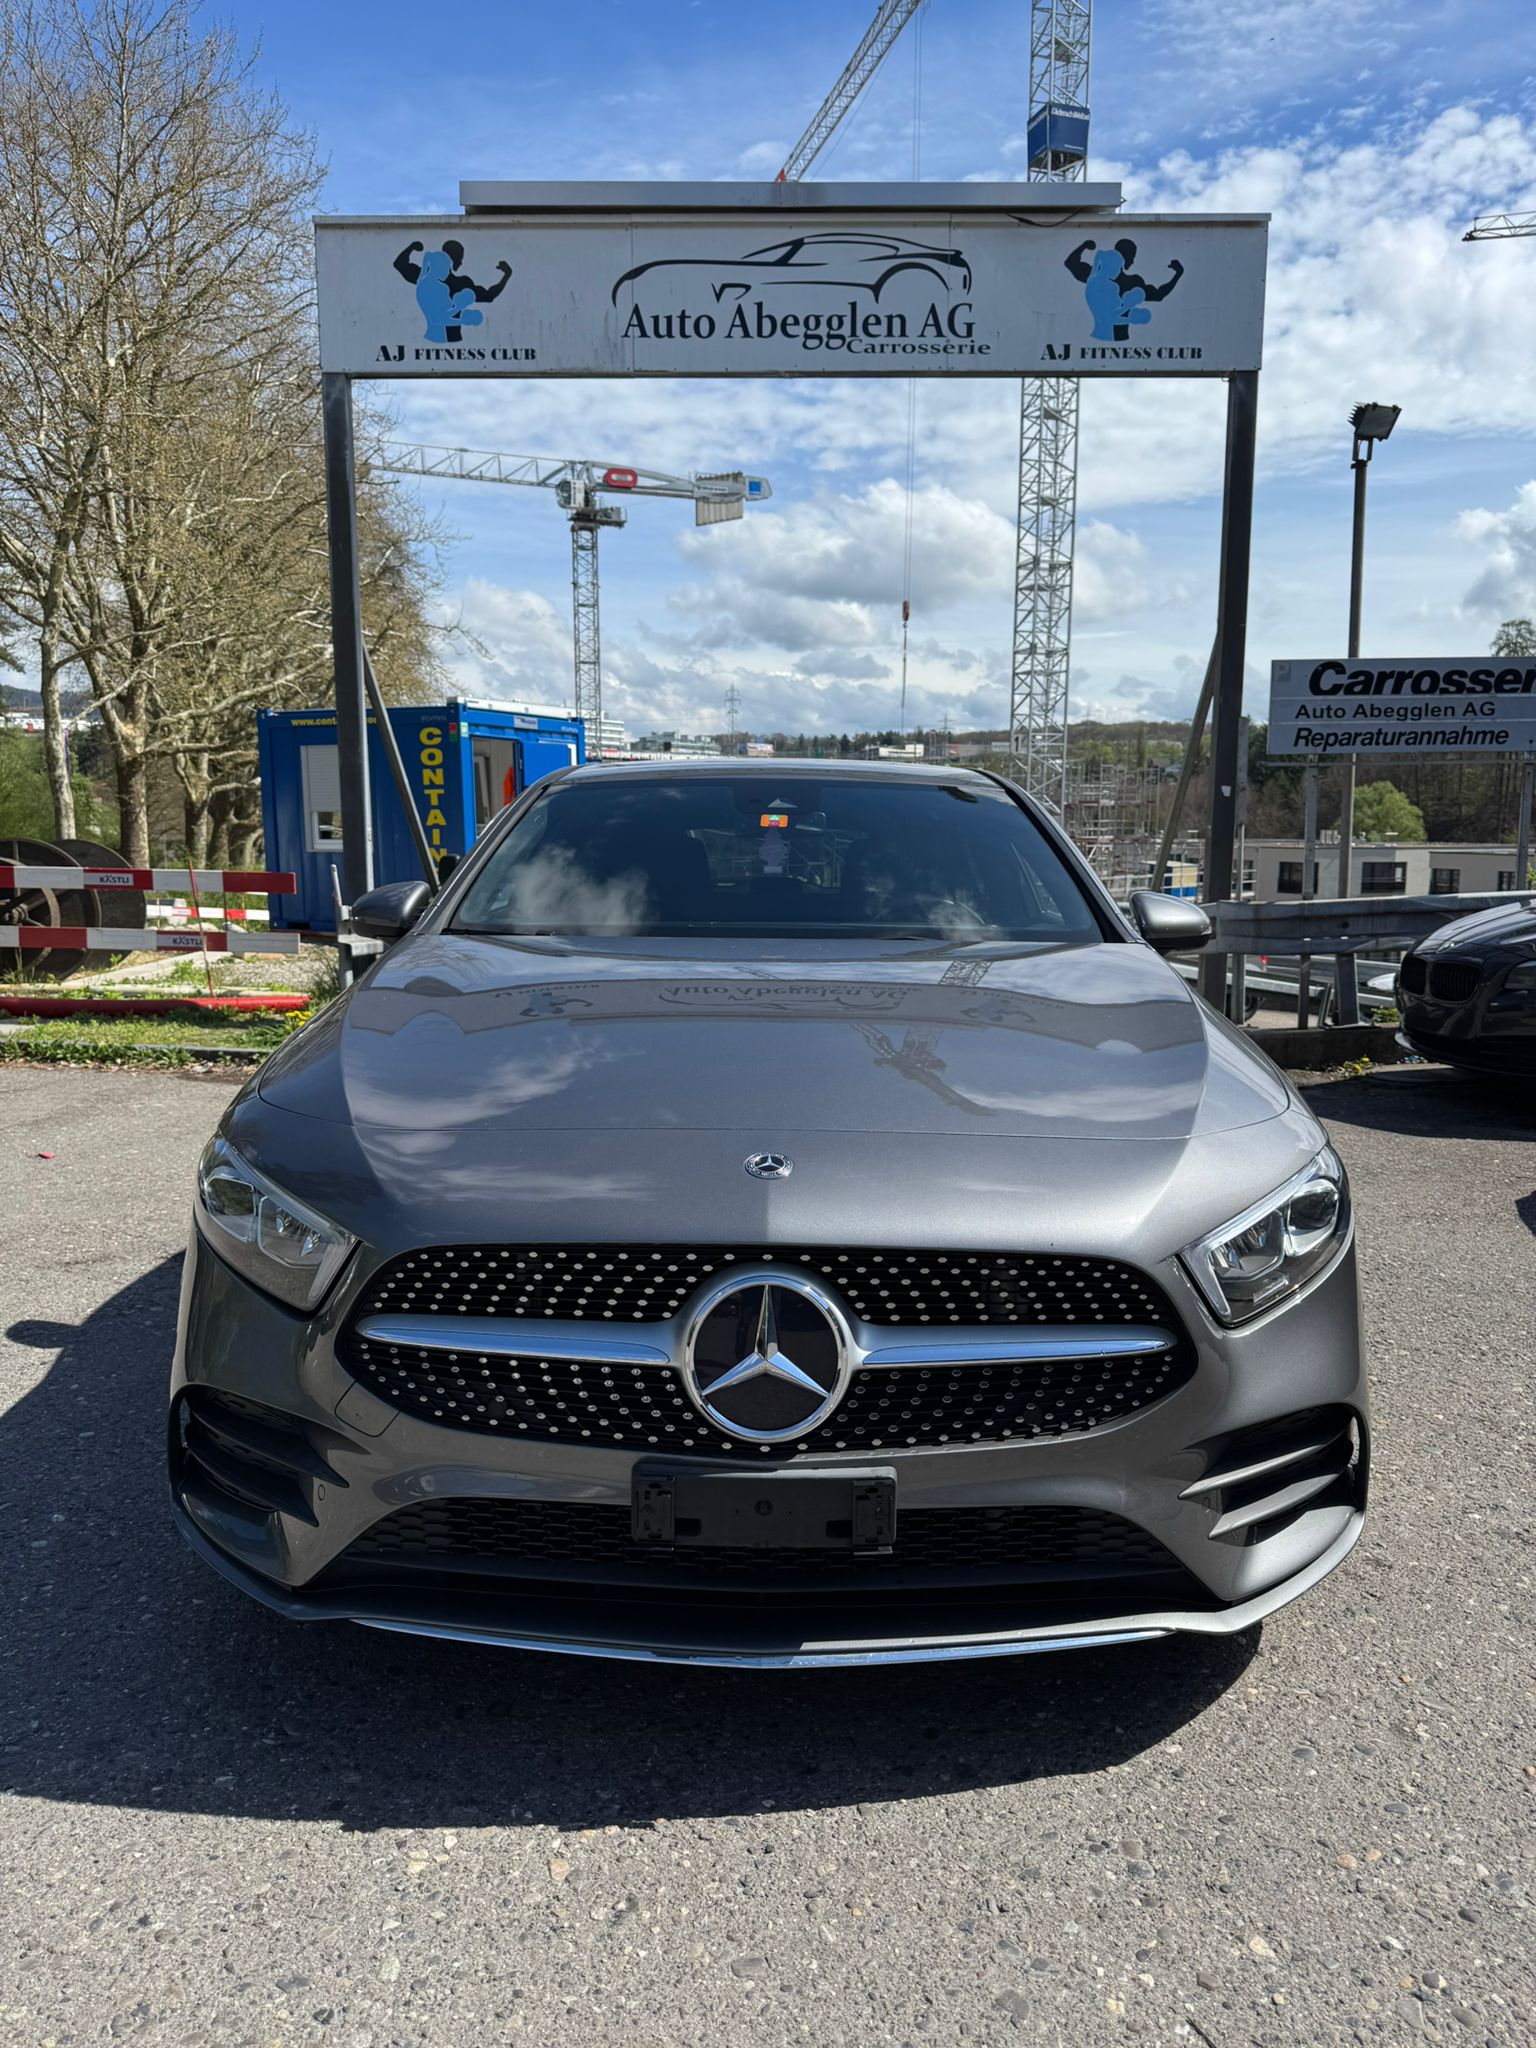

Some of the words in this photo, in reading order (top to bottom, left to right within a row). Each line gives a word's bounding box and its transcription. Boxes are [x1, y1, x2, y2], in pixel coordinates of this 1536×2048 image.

[621, 303, 716, 339] Auto
[723, 301, 909, 351] Abegglen
[917, 302, 976, 339] AG
[375, 344, 406, 362] AJ
[414, 347, 486, 361] FITNESS
[490, 347, 537, 361] CLUB
[846, 338, 992, 355] Carrosserie
[1040, 343, 1072, 361] AJ
[1080, 346, 1152, 360] FITNESS
[1156, 346, 1203, 360] CLUB
[1295, 704, 1346, 719] Auto
[1352, 702, 1456, 721] Abegglen
[1462, 701, 1496, 717] AG
[1293, 726, 1510, 752] Reparaturannahme
